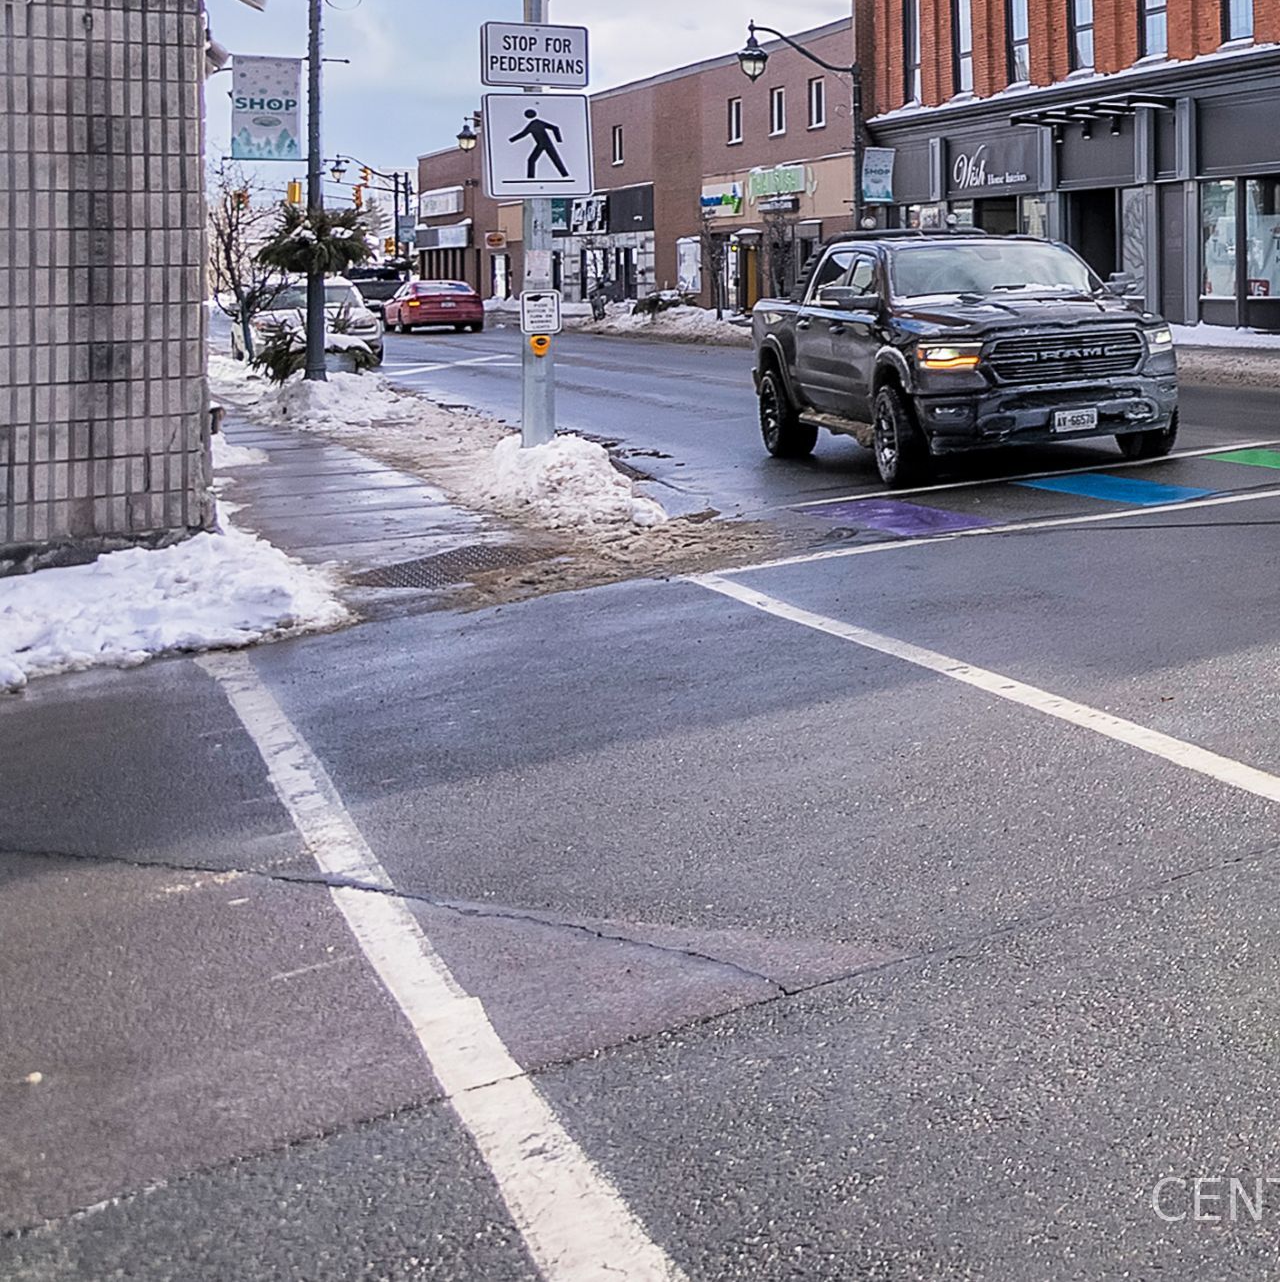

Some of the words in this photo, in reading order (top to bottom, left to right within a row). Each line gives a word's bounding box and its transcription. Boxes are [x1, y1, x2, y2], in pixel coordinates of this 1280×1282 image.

[502, 35, 537, 51] STOP
[545, 37, 572, 54] FOR
[489, 55, 584, 75] PEDESTRIANS
[235, 97, 297, 111] SHOP
[864, 167, 890, 176] SHOP
[953, 144, 985, 189] Wish
[1040, 347, 1102, 360] RAM
